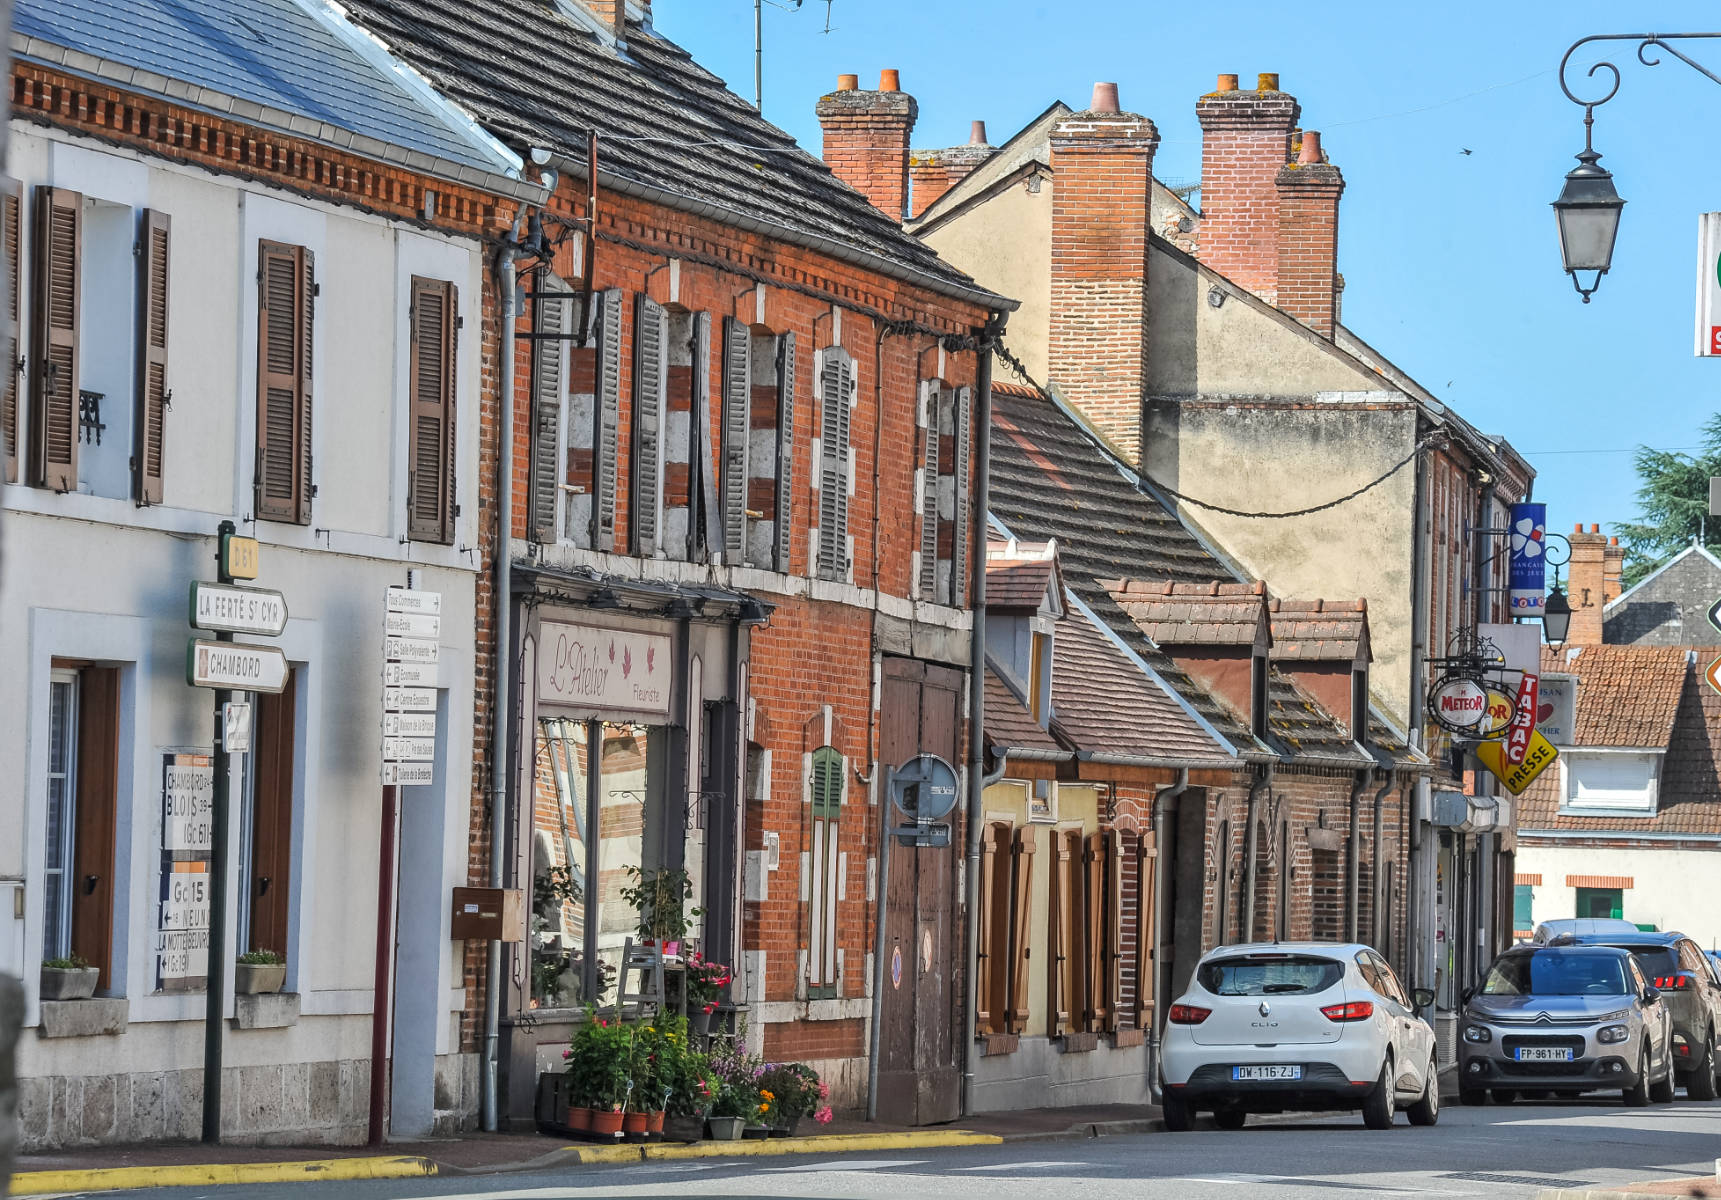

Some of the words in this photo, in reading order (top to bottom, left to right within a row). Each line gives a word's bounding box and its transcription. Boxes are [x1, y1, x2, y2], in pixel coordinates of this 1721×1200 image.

[200, 594, 210, 617] LA
[216, 594, 244, 620] FERTÉ
[261, 601, 278, 624] CYR
[210, 653, 260, 679] CHAMBORD
[633, 683, 660, 703] Fleuriste
[1441, 695, 1483, 712] METEOR
[1510, 678, 1536, 761] TABAC
[1508, 745, 1550, 789] PRESSE
[168, 772, 203, 791] CHAMBORD
[167, 795, 197, 817] BLOIS
[200, 800, 207, 812] 39
[174, 881, 188, 902] Gc
[192, 881, 204, 902] 15
[168, 932, 187, 951] MOTTE
[1240, 1066, 1294, 1078] DW-116-ZJ
